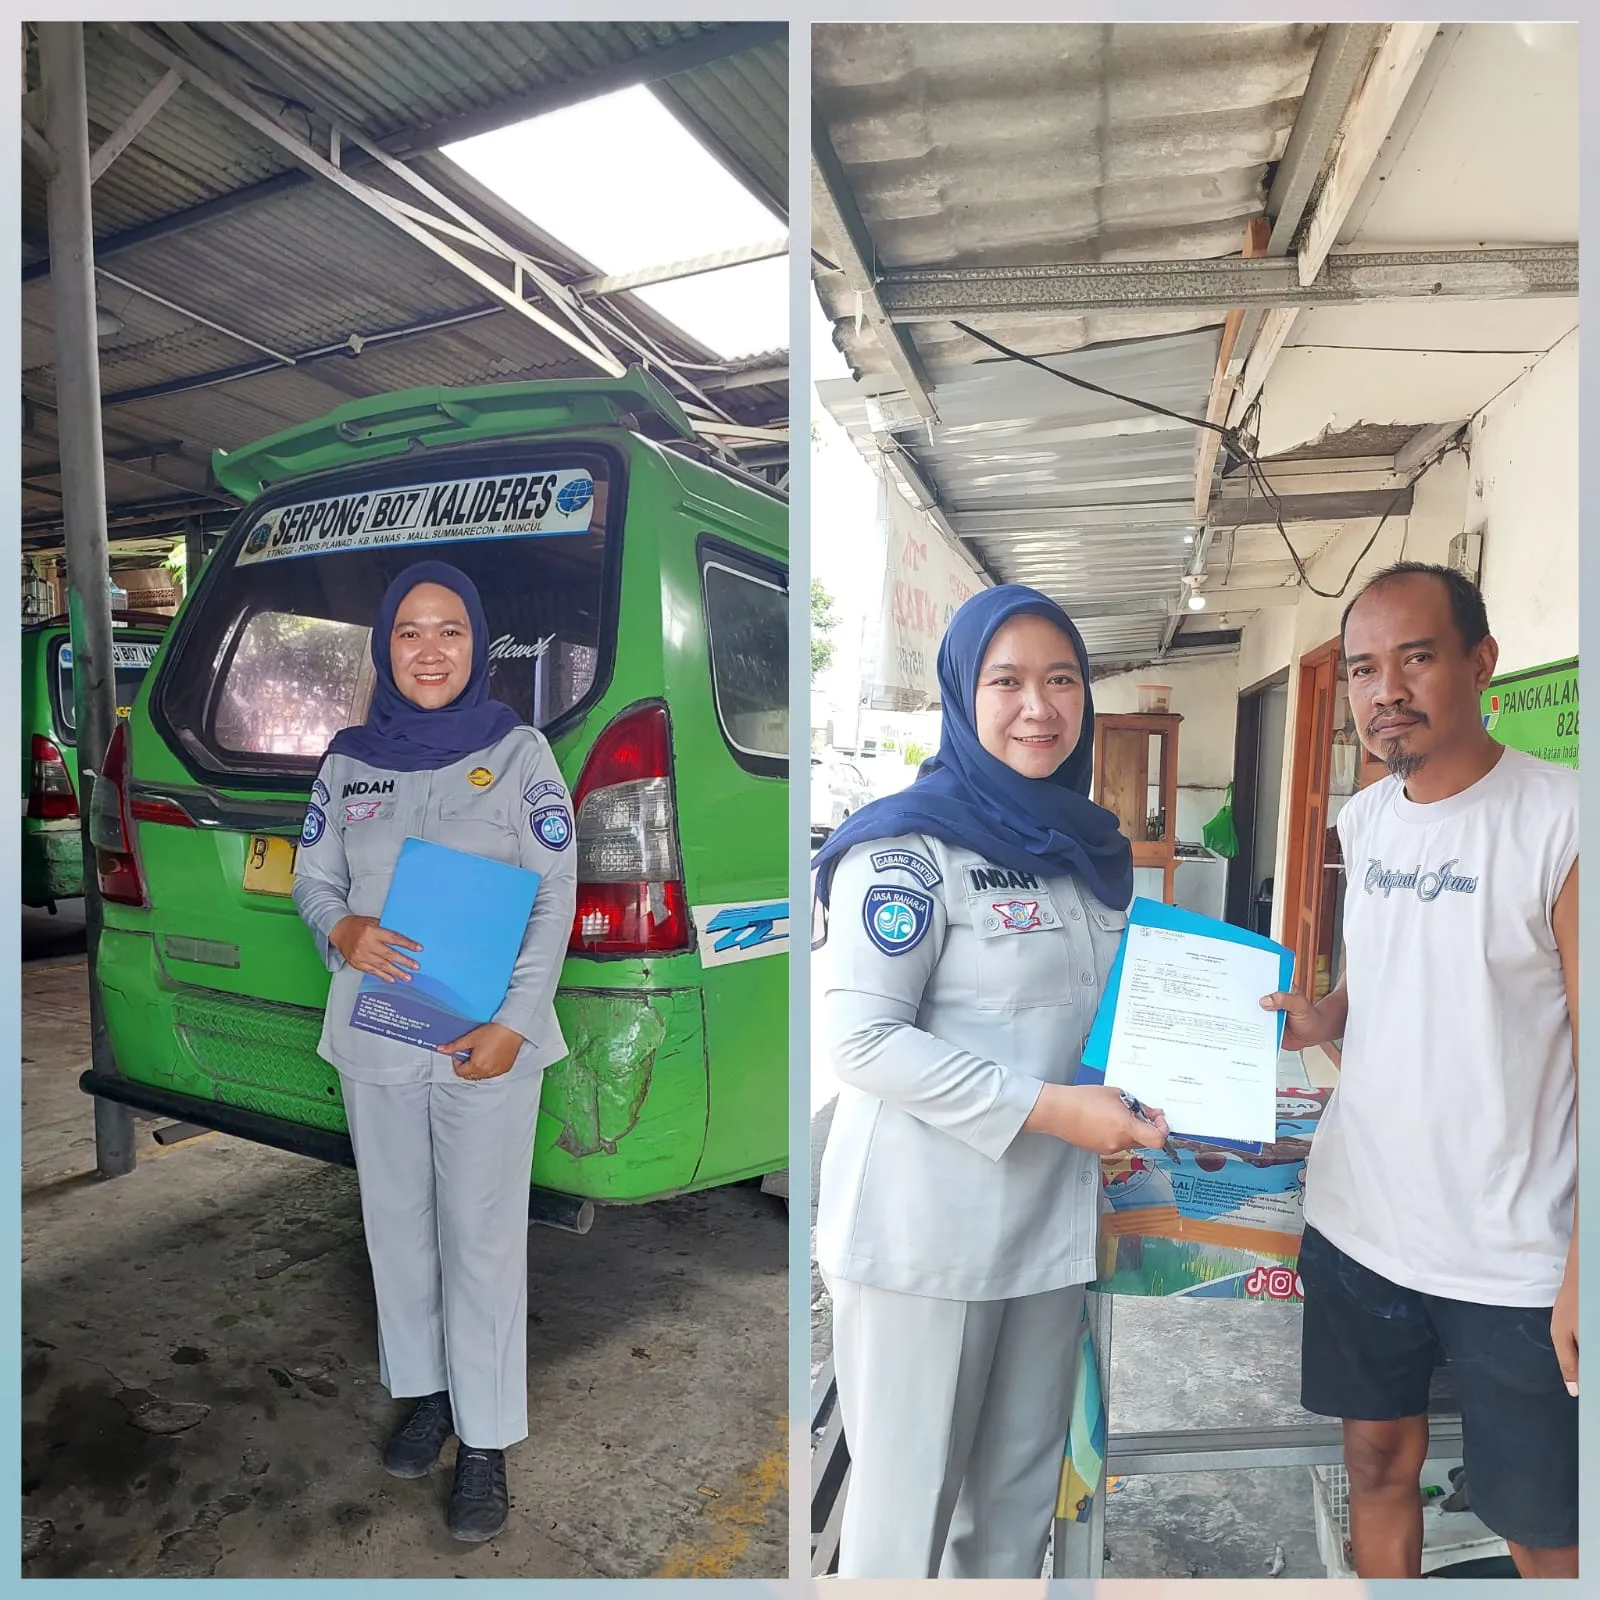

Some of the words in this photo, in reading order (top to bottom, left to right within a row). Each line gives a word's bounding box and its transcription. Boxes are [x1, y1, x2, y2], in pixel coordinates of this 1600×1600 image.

[271, 495, 369, 547] SERPONG
[371, 493, 421, 529] B07
[423, 474, 558, 527] KALIDERES
[299, 542, 320, 552] PORIS
[373, 533, 401, 543] NANAS
[407, 531, 430, 541] MALL
[431, 525, 496, 539] SUMMARECON
[502, 522, 543, 534] MUNCUL
[1503, 678, 1579, 714] PANGKALAN
[1563, 744, 1579, 758] Inda
[342, 779, 394, 799] INDAH
[877, 855, 909, 866] CABANG
[910, 859, 936, 884] BANTEN
[970, 868, 1038, 891] INDAH
[871, 892, 892, 902] JASA
[893, 893, 926, 913] RAHARJA
[1172, 1180, 1190, 1190] LAL
